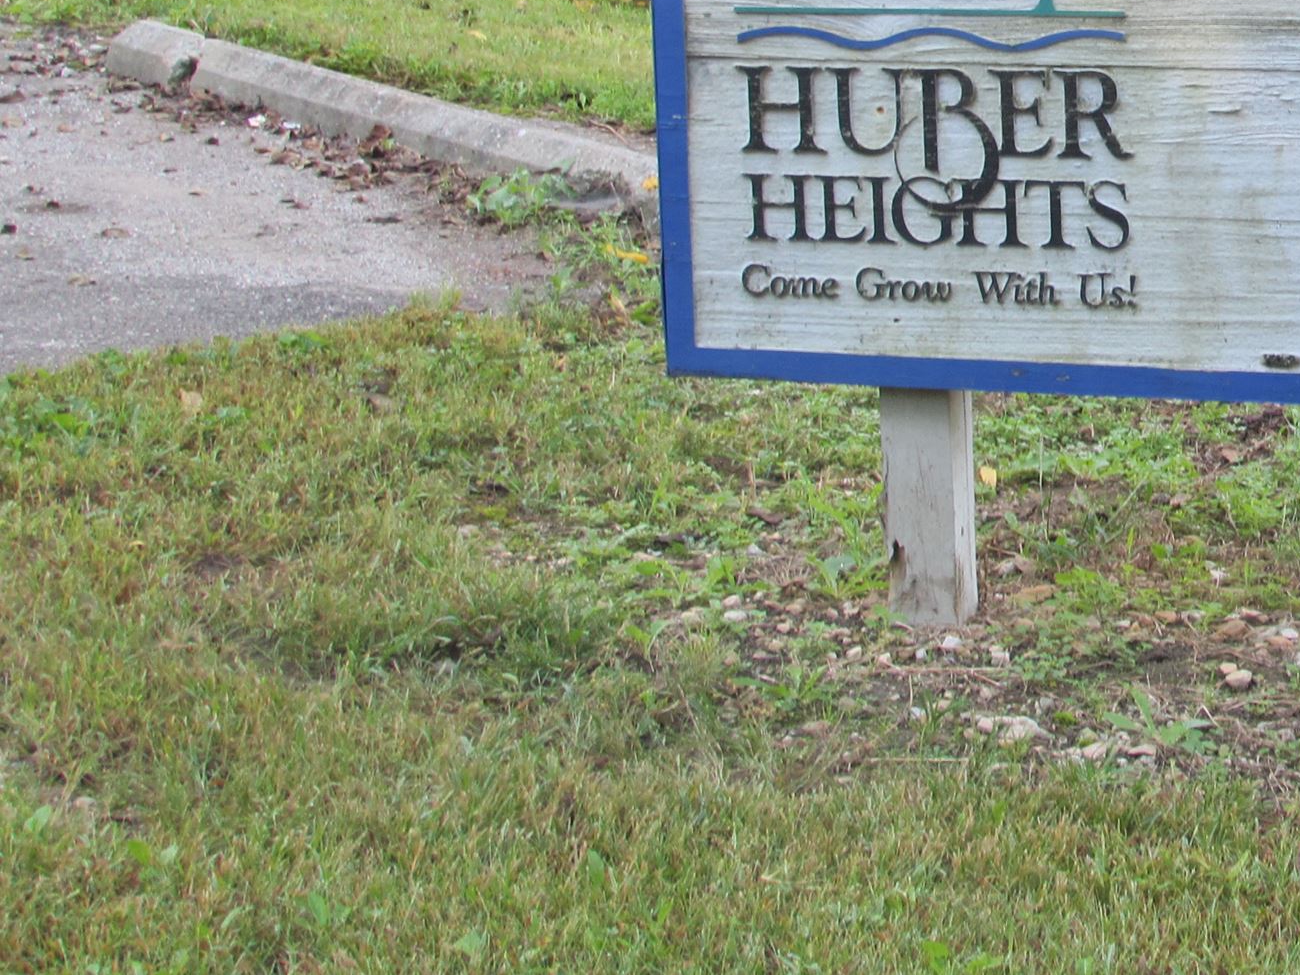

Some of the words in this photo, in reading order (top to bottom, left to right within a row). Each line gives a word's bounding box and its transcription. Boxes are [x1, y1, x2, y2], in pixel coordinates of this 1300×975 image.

[735, 66, 1134, 211] HUBER
[742, 173, 1129, 250] HEIGHTS
[742, 264, 838, 299] Come
[856, 268, 951, 302] Grow
[977, 271, 1058, 306] With
[1079, 272, 1137, 309] Us!
